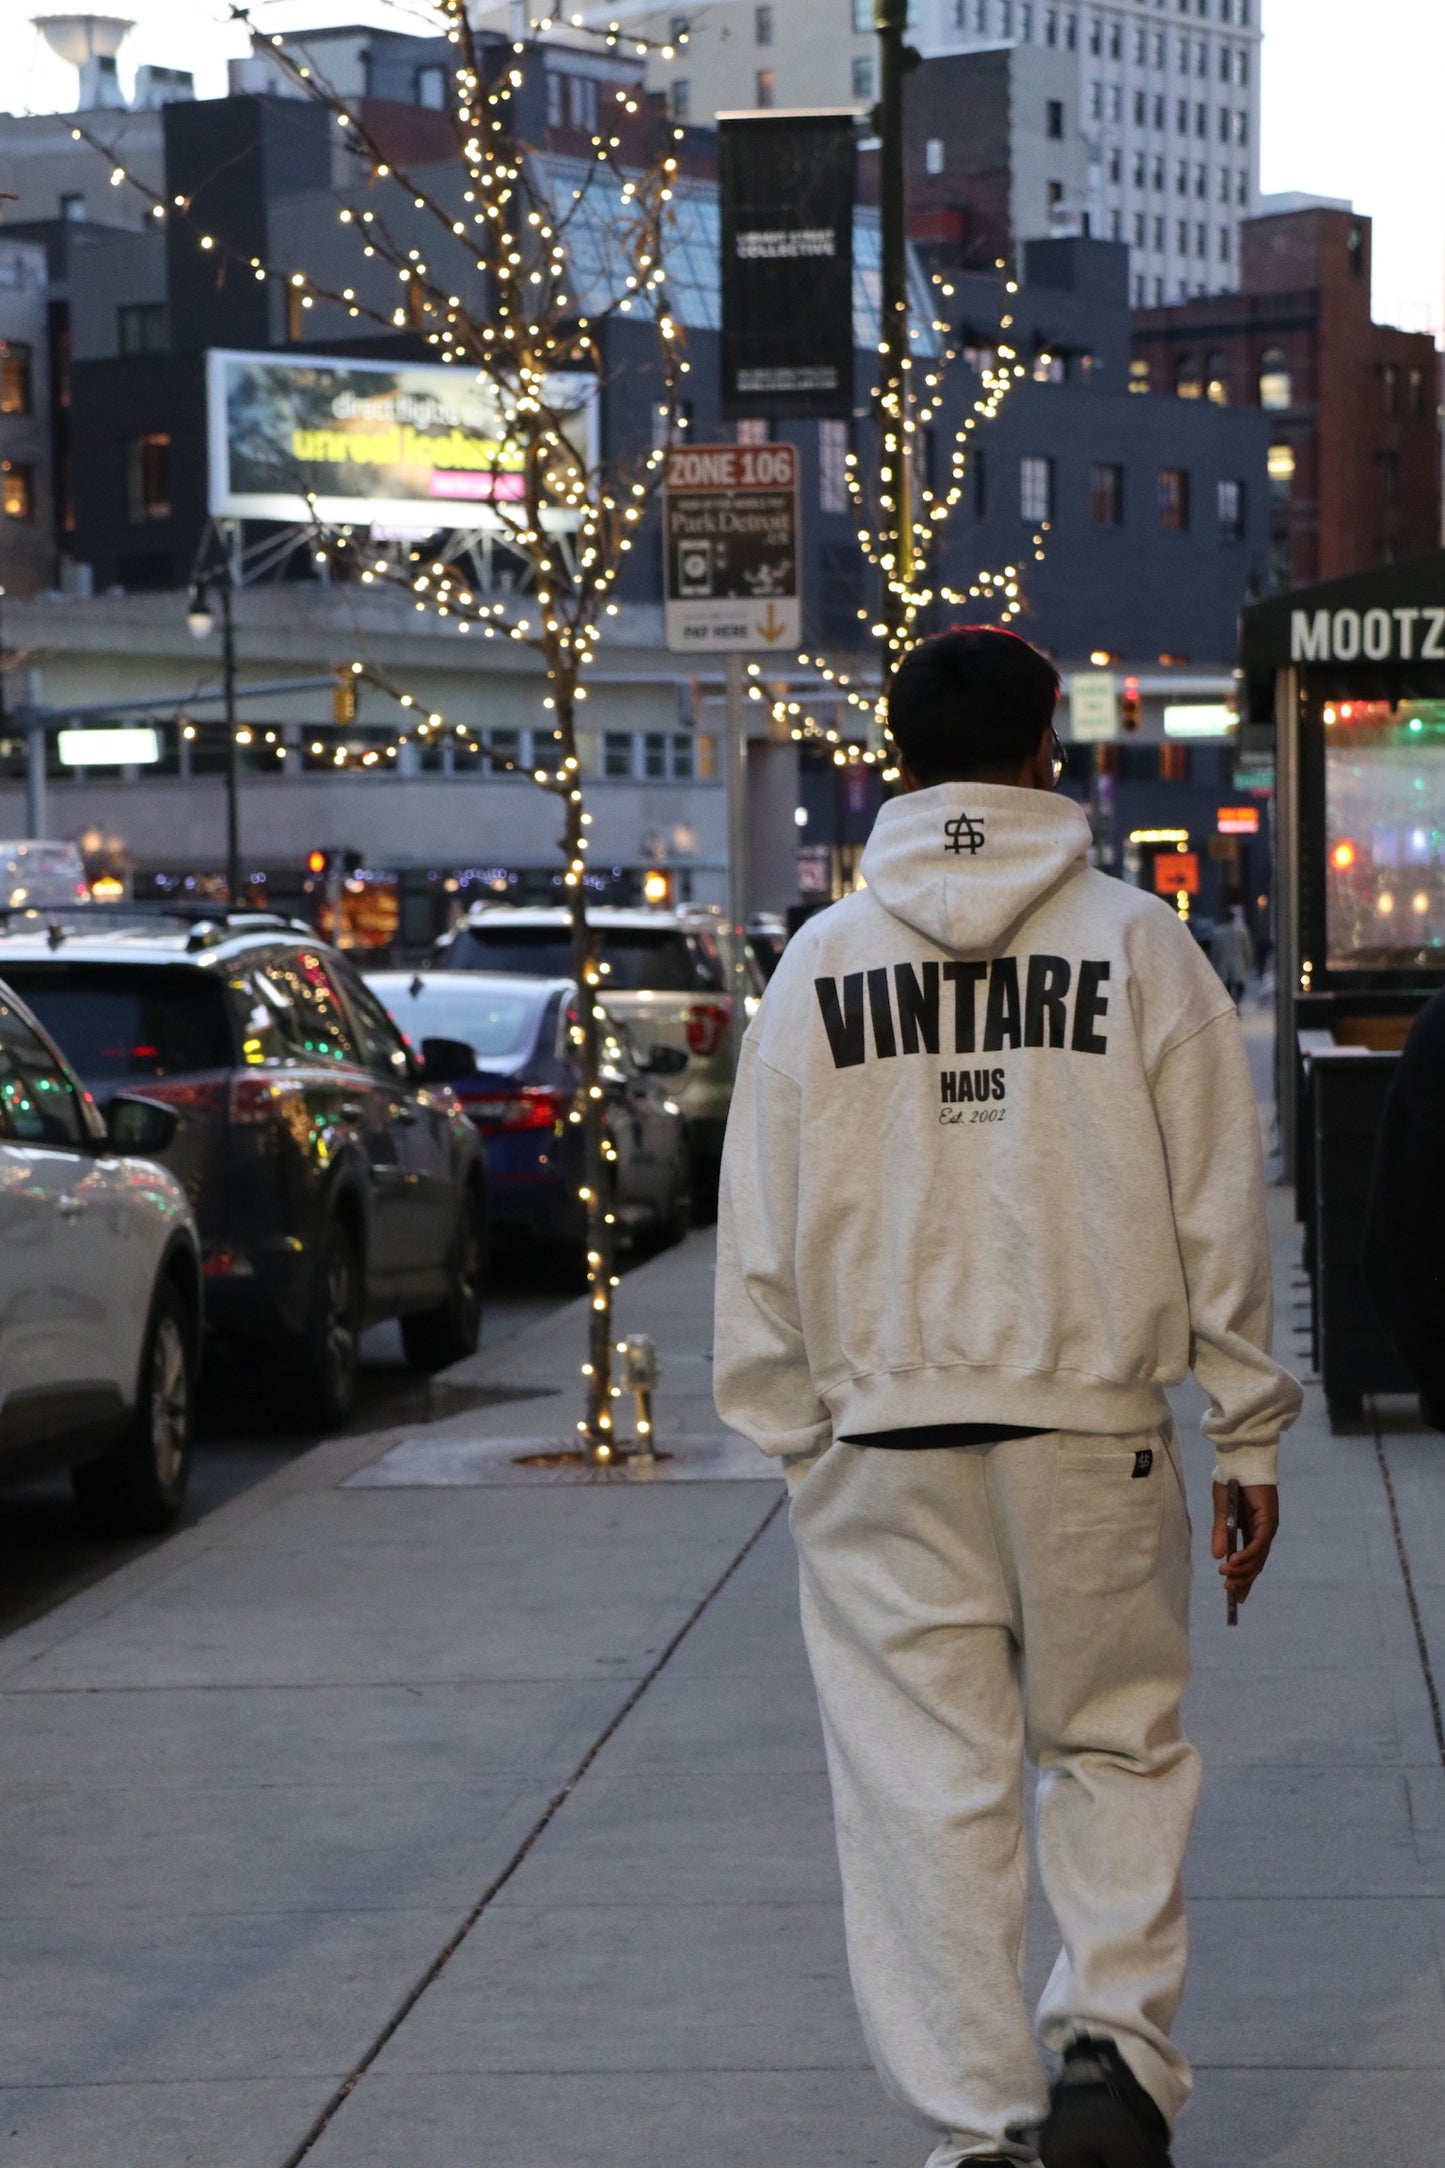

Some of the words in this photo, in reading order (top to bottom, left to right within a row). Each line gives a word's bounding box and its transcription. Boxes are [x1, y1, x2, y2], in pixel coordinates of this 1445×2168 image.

[736, 243, 836, 259] COLLECTIVE
[292, 425, 399, 463] unreal
[669, 453, 737, 486] ZONE
[741, 451, 792, 484] 106
[1290, 607, 1445, 661] MOOTZ
[814, 955, 1110, 1069] VINTARE
[940, 1068, 1006, 1103] HAUS
[939, 1107, 965, 1125] Est.
[969, 1108, 1006, 1123] 2002
